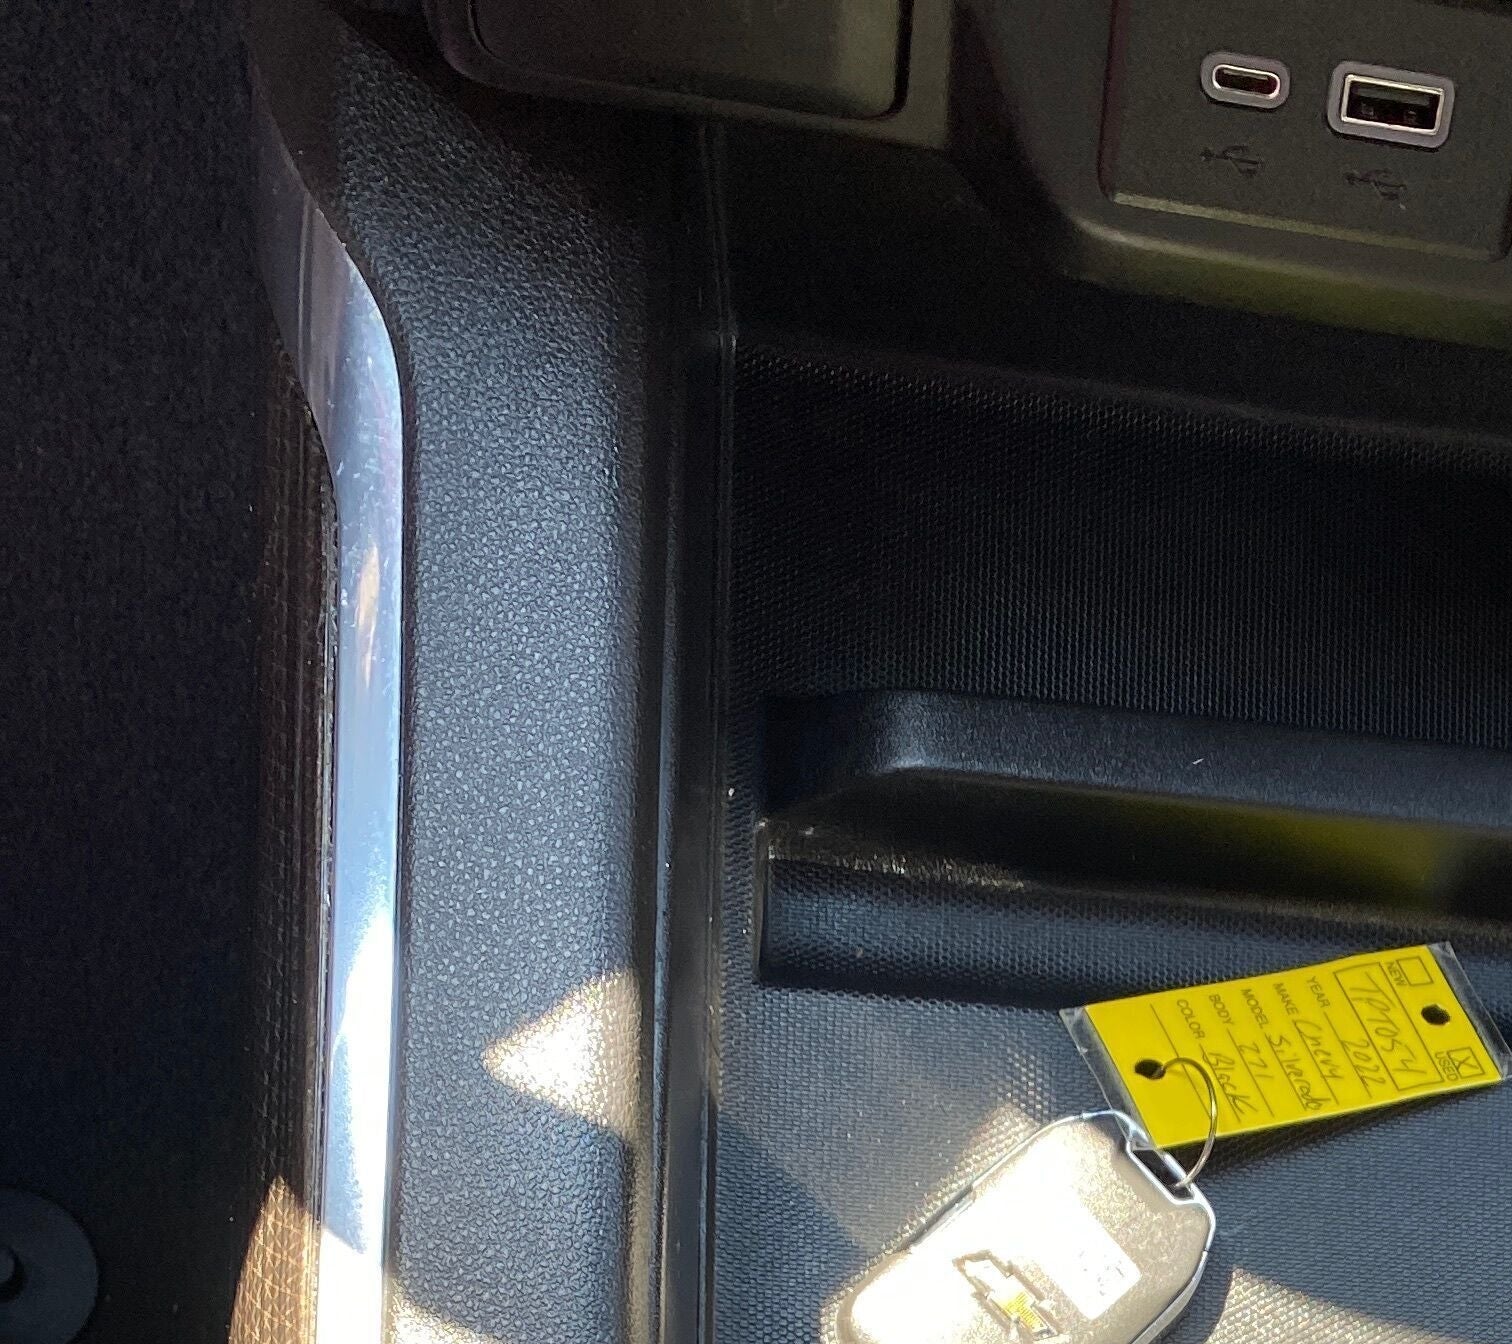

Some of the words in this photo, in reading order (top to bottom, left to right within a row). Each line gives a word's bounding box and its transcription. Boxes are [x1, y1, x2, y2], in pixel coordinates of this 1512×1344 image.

[1386, 961, 1407, 988] NEW
[1208, 993, 1235, 1027] BODY
[1240, 987, 1269, 1030] MODEL
[1272, 981, 1300, 1017] MAKE
[1176, 998, 1206, 1040] COLOR
[1306, 975, 1331, 1009] YEAR
[1342, 1039, 1387, 1087] 2022
[1434, 1050, 1460, 1082] USED
